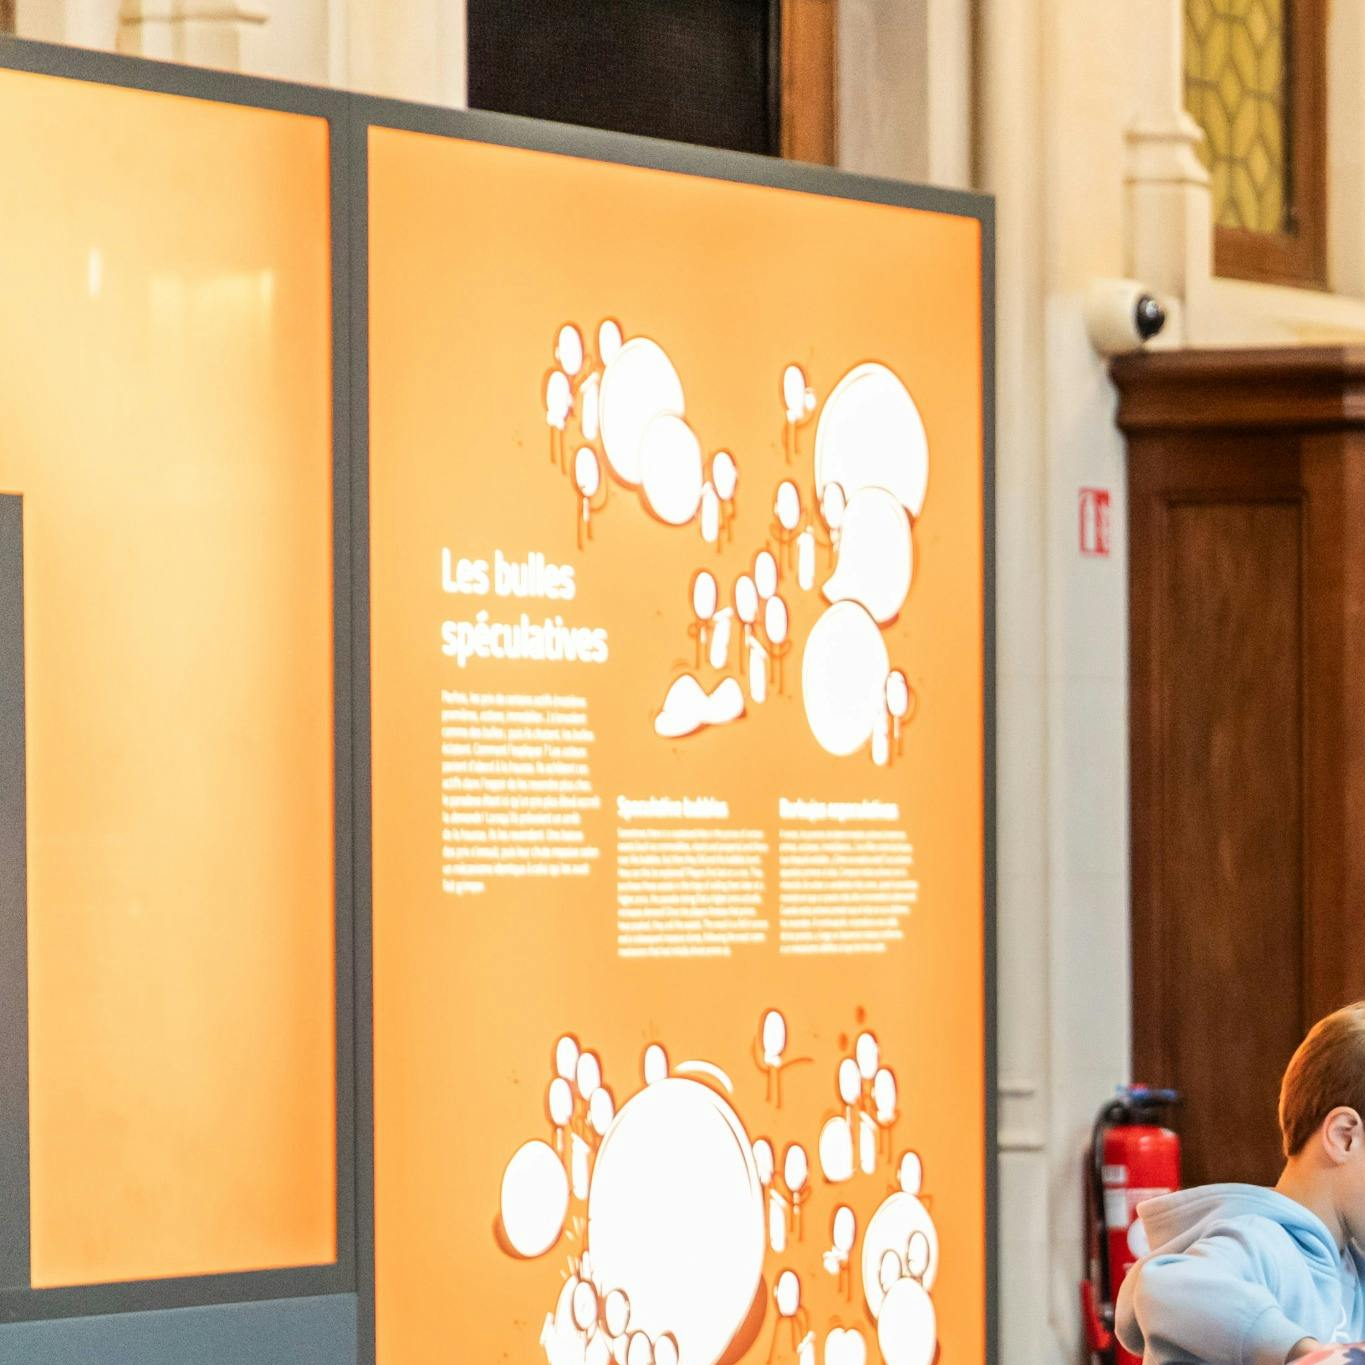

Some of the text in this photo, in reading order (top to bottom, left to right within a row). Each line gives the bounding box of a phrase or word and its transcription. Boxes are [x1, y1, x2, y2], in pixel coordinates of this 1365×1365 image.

[442, 547, 576, 600] Les bulles
[441, 609, 608, 669] spéculatives
